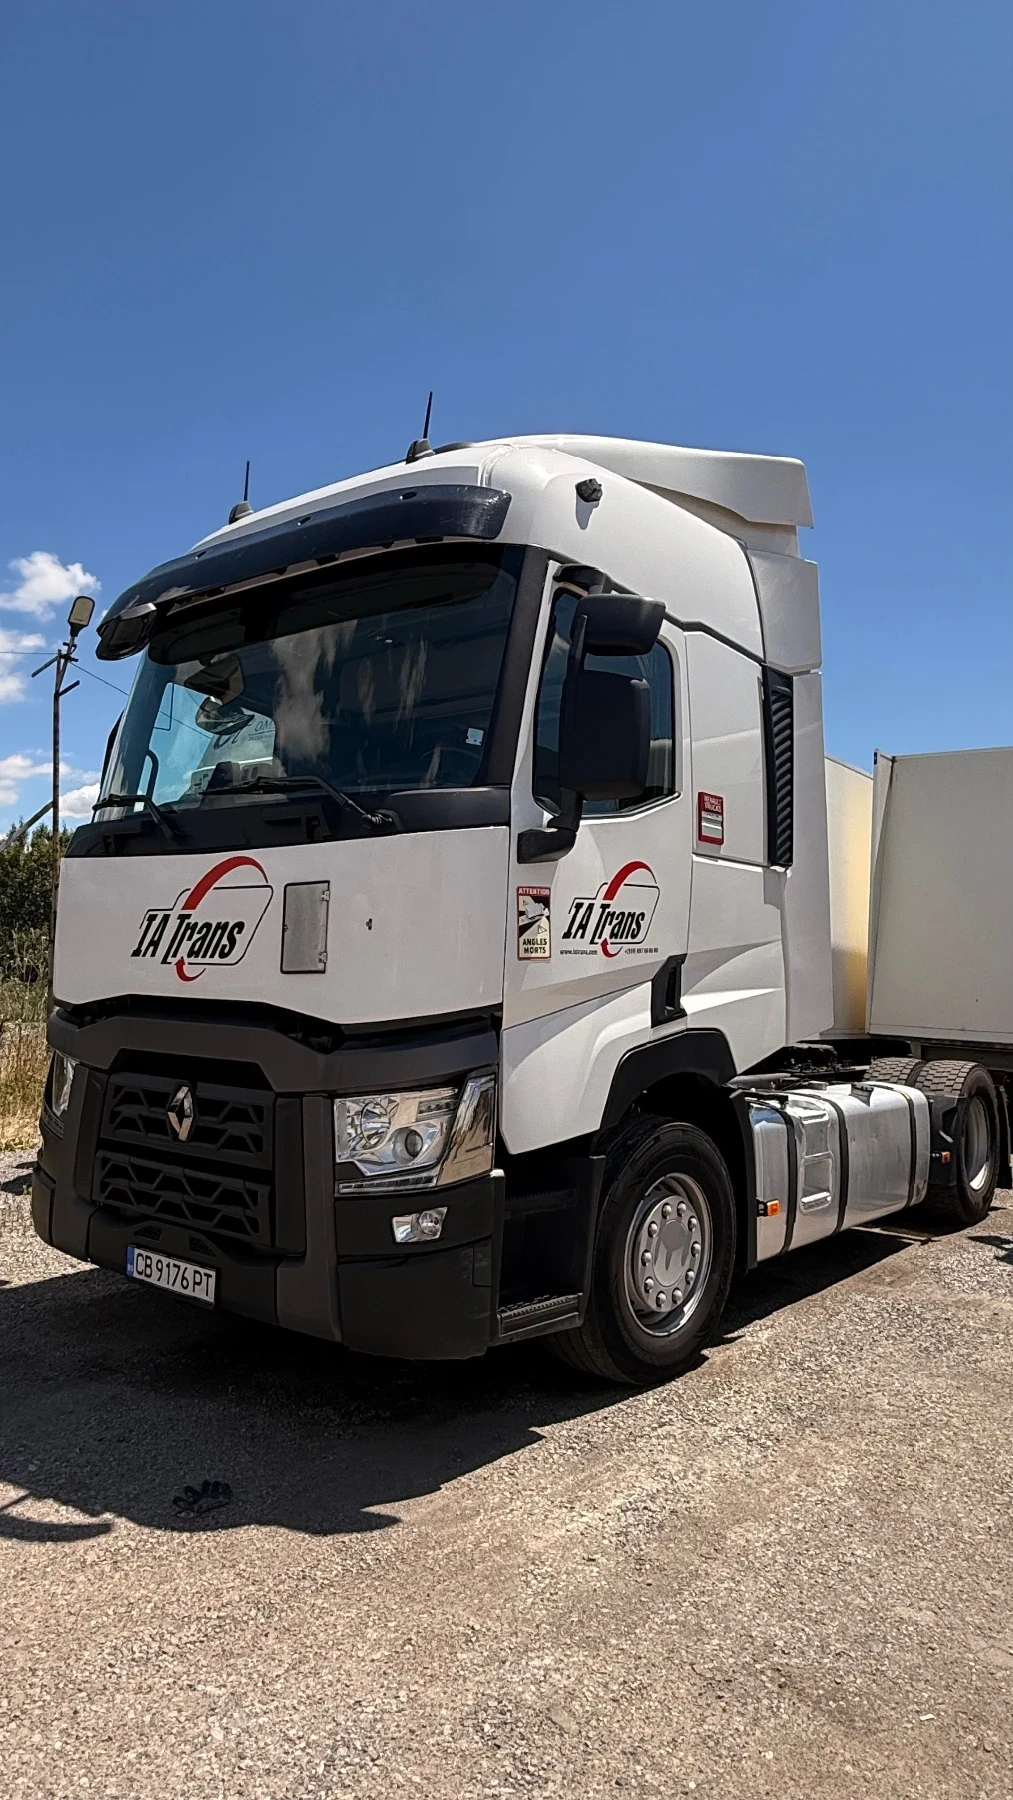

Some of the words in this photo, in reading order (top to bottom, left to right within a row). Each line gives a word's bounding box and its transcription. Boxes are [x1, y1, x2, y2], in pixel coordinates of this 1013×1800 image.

[518, 887, 550, 895] ATTENTION
[561, 902, 595, 939] IA
[589, 903, 646, 945] Trans
[130, 913, 171, 957] IA
[160, 913, 245, 964] Trans
[522, 938, 548, 946] ANGLES
[523, 946, 547, 954] MORTS
